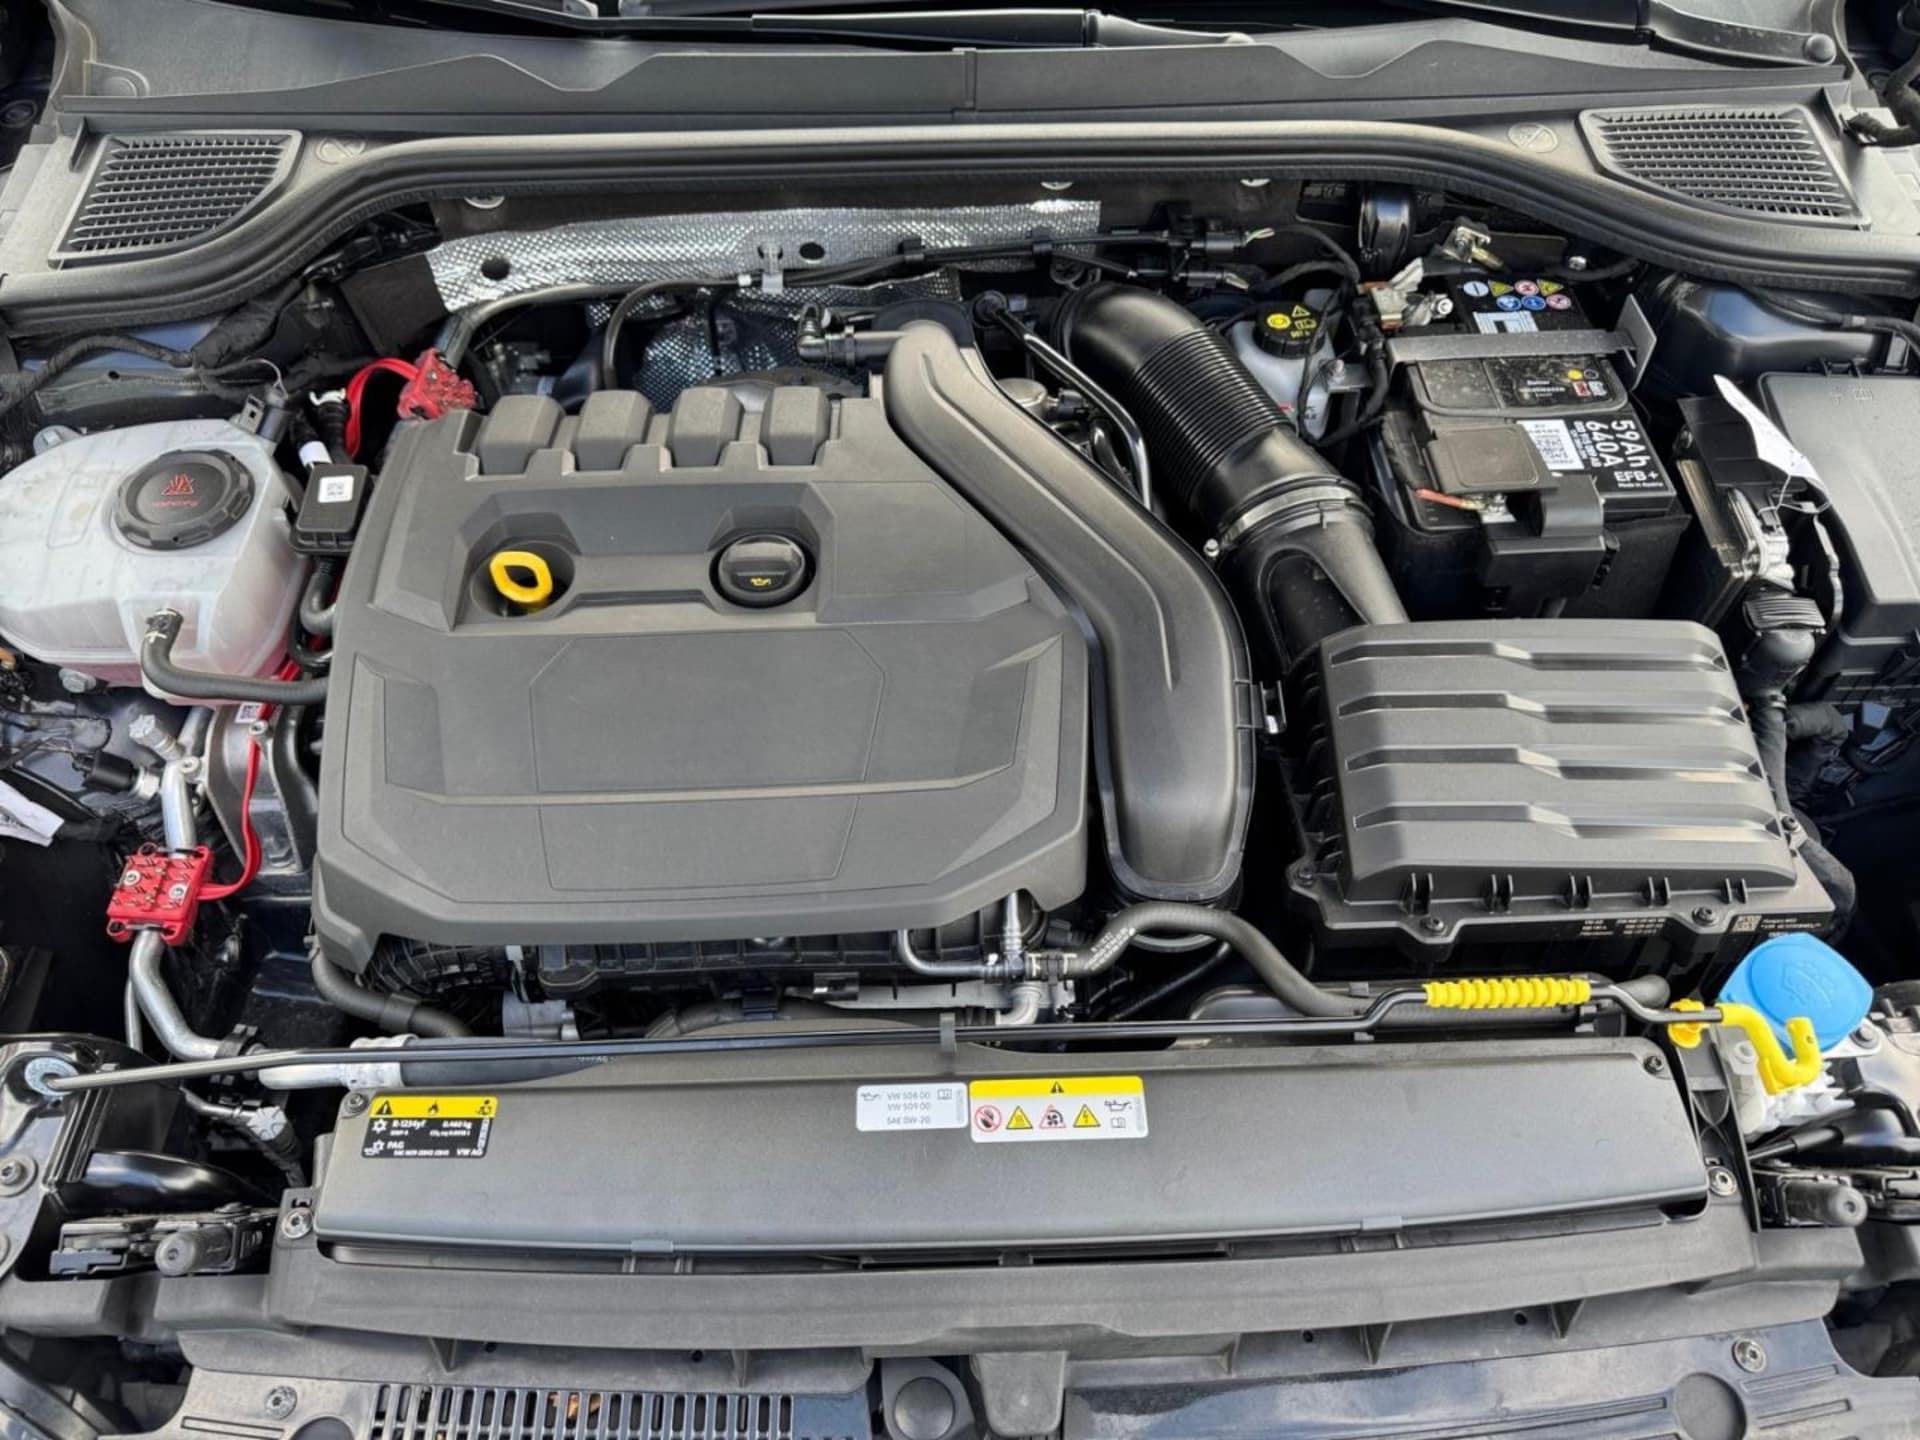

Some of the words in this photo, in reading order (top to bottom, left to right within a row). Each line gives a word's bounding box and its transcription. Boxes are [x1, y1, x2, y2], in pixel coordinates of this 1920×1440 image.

[1585, 421, 1624, 467] 640A
[1611, 420, 1651, 467] 59Ah
[886, 1092, 900, 1100] VW
[887, 1102, 900, 1111] VW
